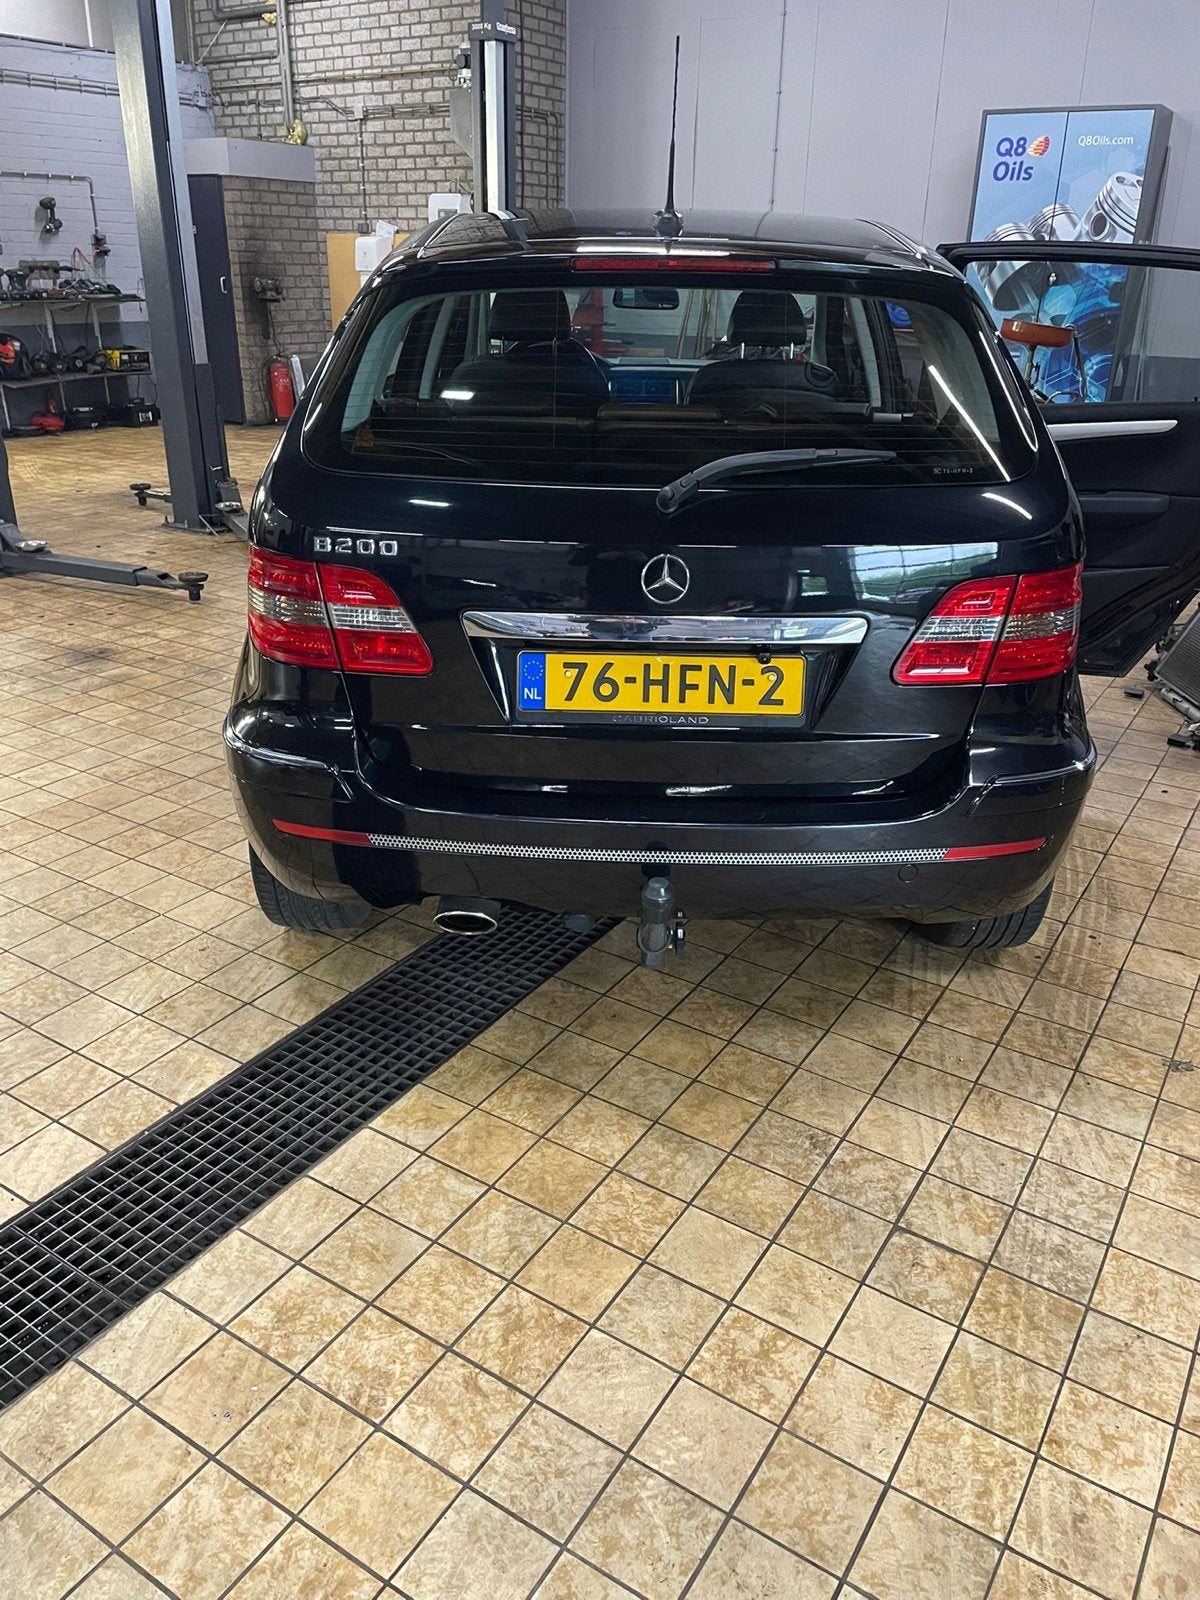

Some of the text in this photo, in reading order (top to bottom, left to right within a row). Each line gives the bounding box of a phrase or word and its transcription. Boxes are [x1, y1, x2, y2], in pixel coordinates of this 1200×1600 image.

[995, 136, 1028, 158] Q8
[1078, 134, 1134, 147] Q8Oils.com
[992, 160, 1034, 182] Oils
[313, 535, 398, 556] B200
[523, 687, 542, 701] NL
[562, 661, 785, 706] 76-HFN-2
